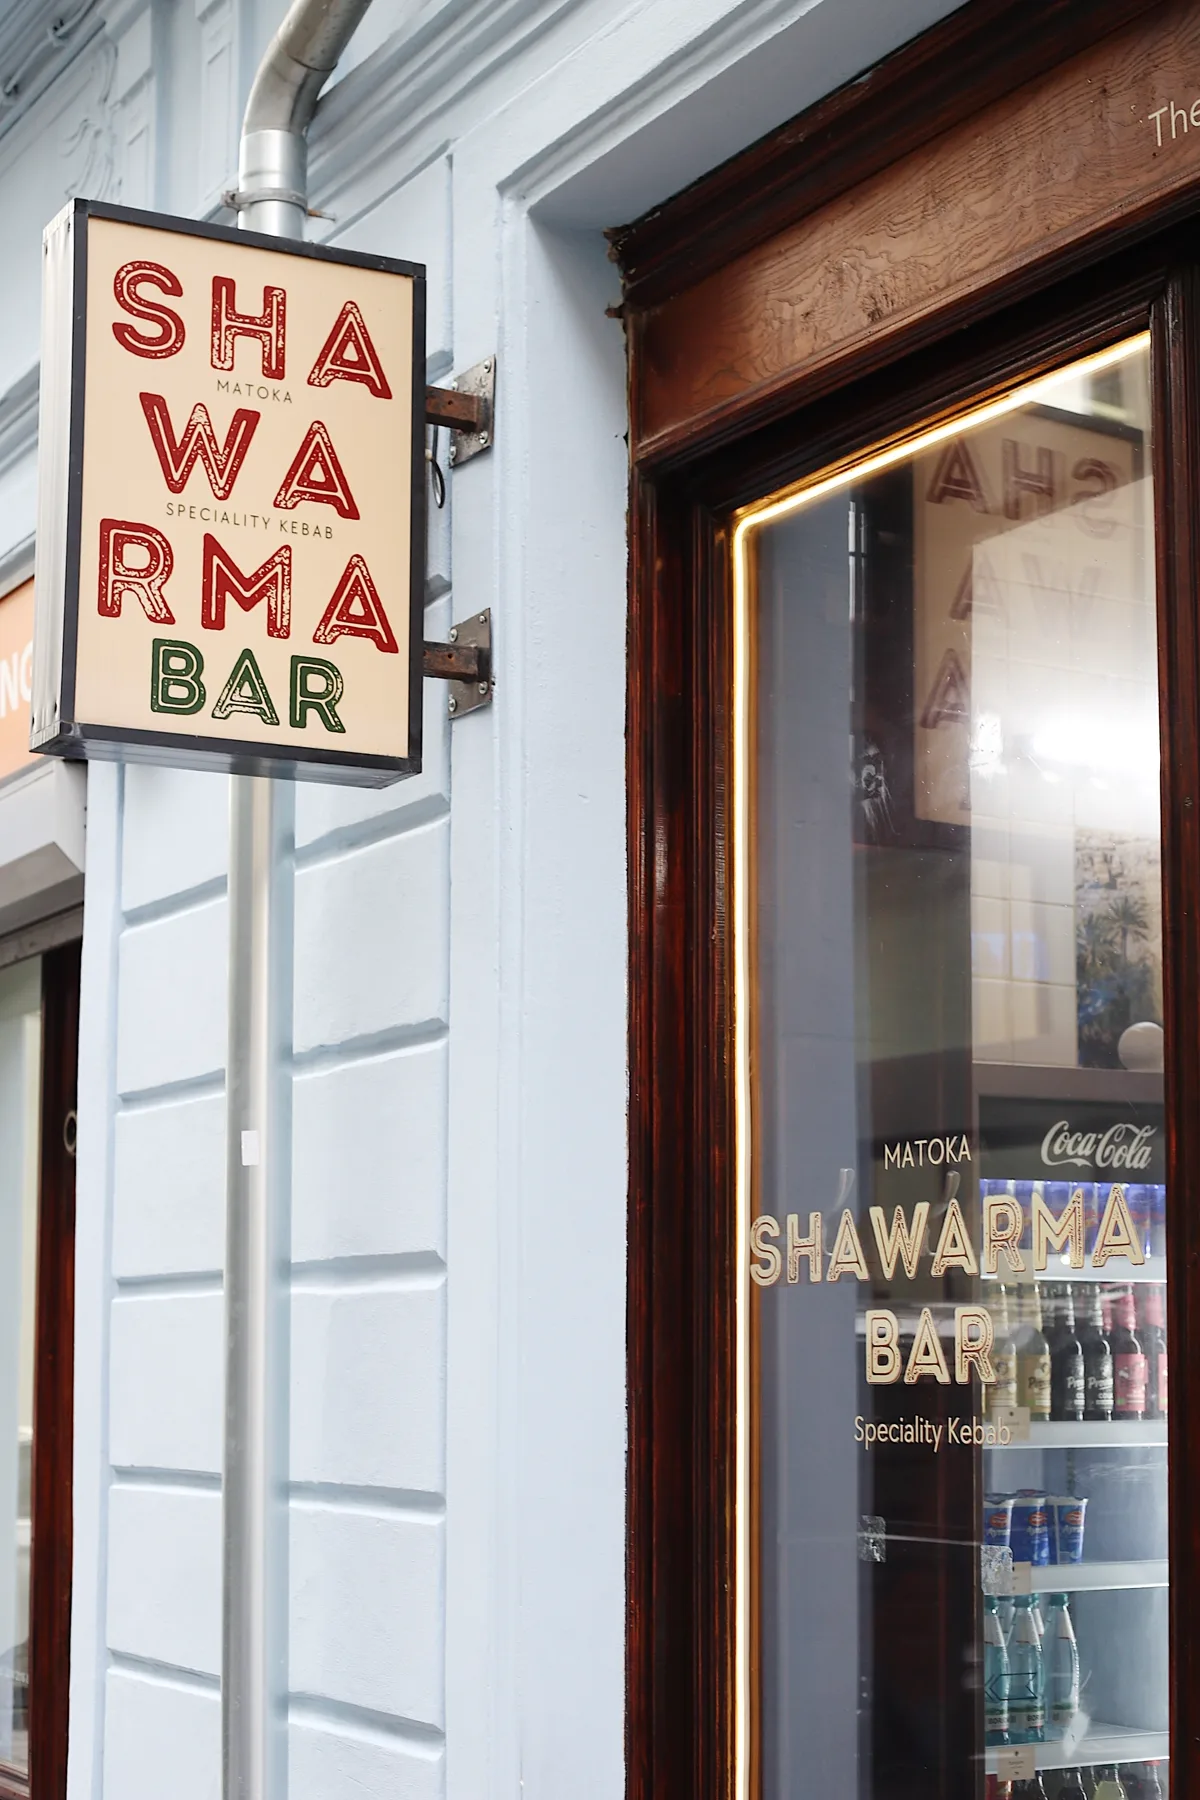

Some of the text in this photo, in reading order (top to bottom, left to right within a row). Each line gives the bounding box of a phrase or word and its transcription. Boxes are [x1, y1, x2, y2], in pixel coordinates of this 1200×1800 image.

[1148, 98, 1200, 146] The
[216, 379, 293, 404] MATOKA
[166, 502, 333, 539] SPECIALITY KEBAB
[149, 638, 346, 733] BAR
[884, 1134, 972, 1170] MATOKA
[1041, 1120, 1158, 1169] Coca-Cola
[750, 1183, 1145, 1287] SHAWARMA
[865, 1306, 997, 1386] BAR
[854, 1415, 1012, 1453] Speciality Kebab
